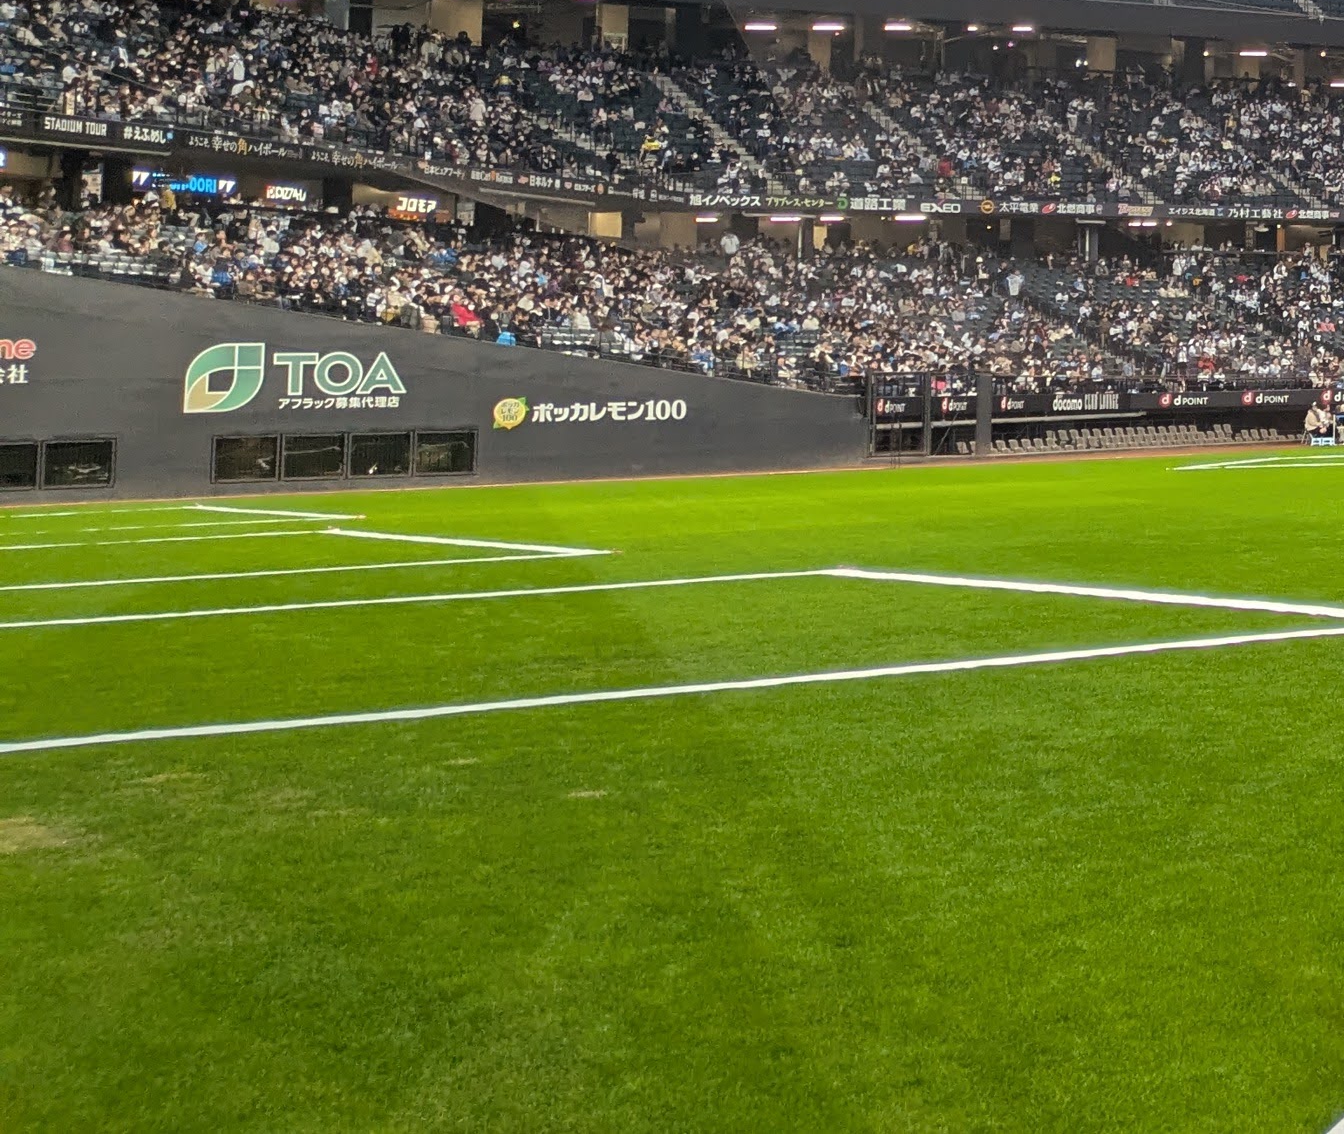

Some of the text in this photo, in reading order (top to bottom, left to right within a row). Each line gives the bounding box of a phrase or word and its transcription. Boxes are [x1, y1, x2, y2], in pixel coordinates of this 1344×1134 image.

[44, 117, 108, 137] STADIUM TOUR
[123, 126, 167, 144] #えふめし
[690, 194, 762, 207] 旭イノベックス
[850, 198, 907, 211] 道路工業
[920, 202, 961, 213] EXEO
[999, 202, 1039, 214] 太平電業
[1228, 207, 1284, 219] 乃村工藝社
[0, 364, 29, 384] 社
[273, 351, 407, 396] TOA
[278, 396, 400, 409] アフラック募集代理店
[1052, 394, 1083, 411] docomo
[532, 399, 687, 423] ポッカレモン100
